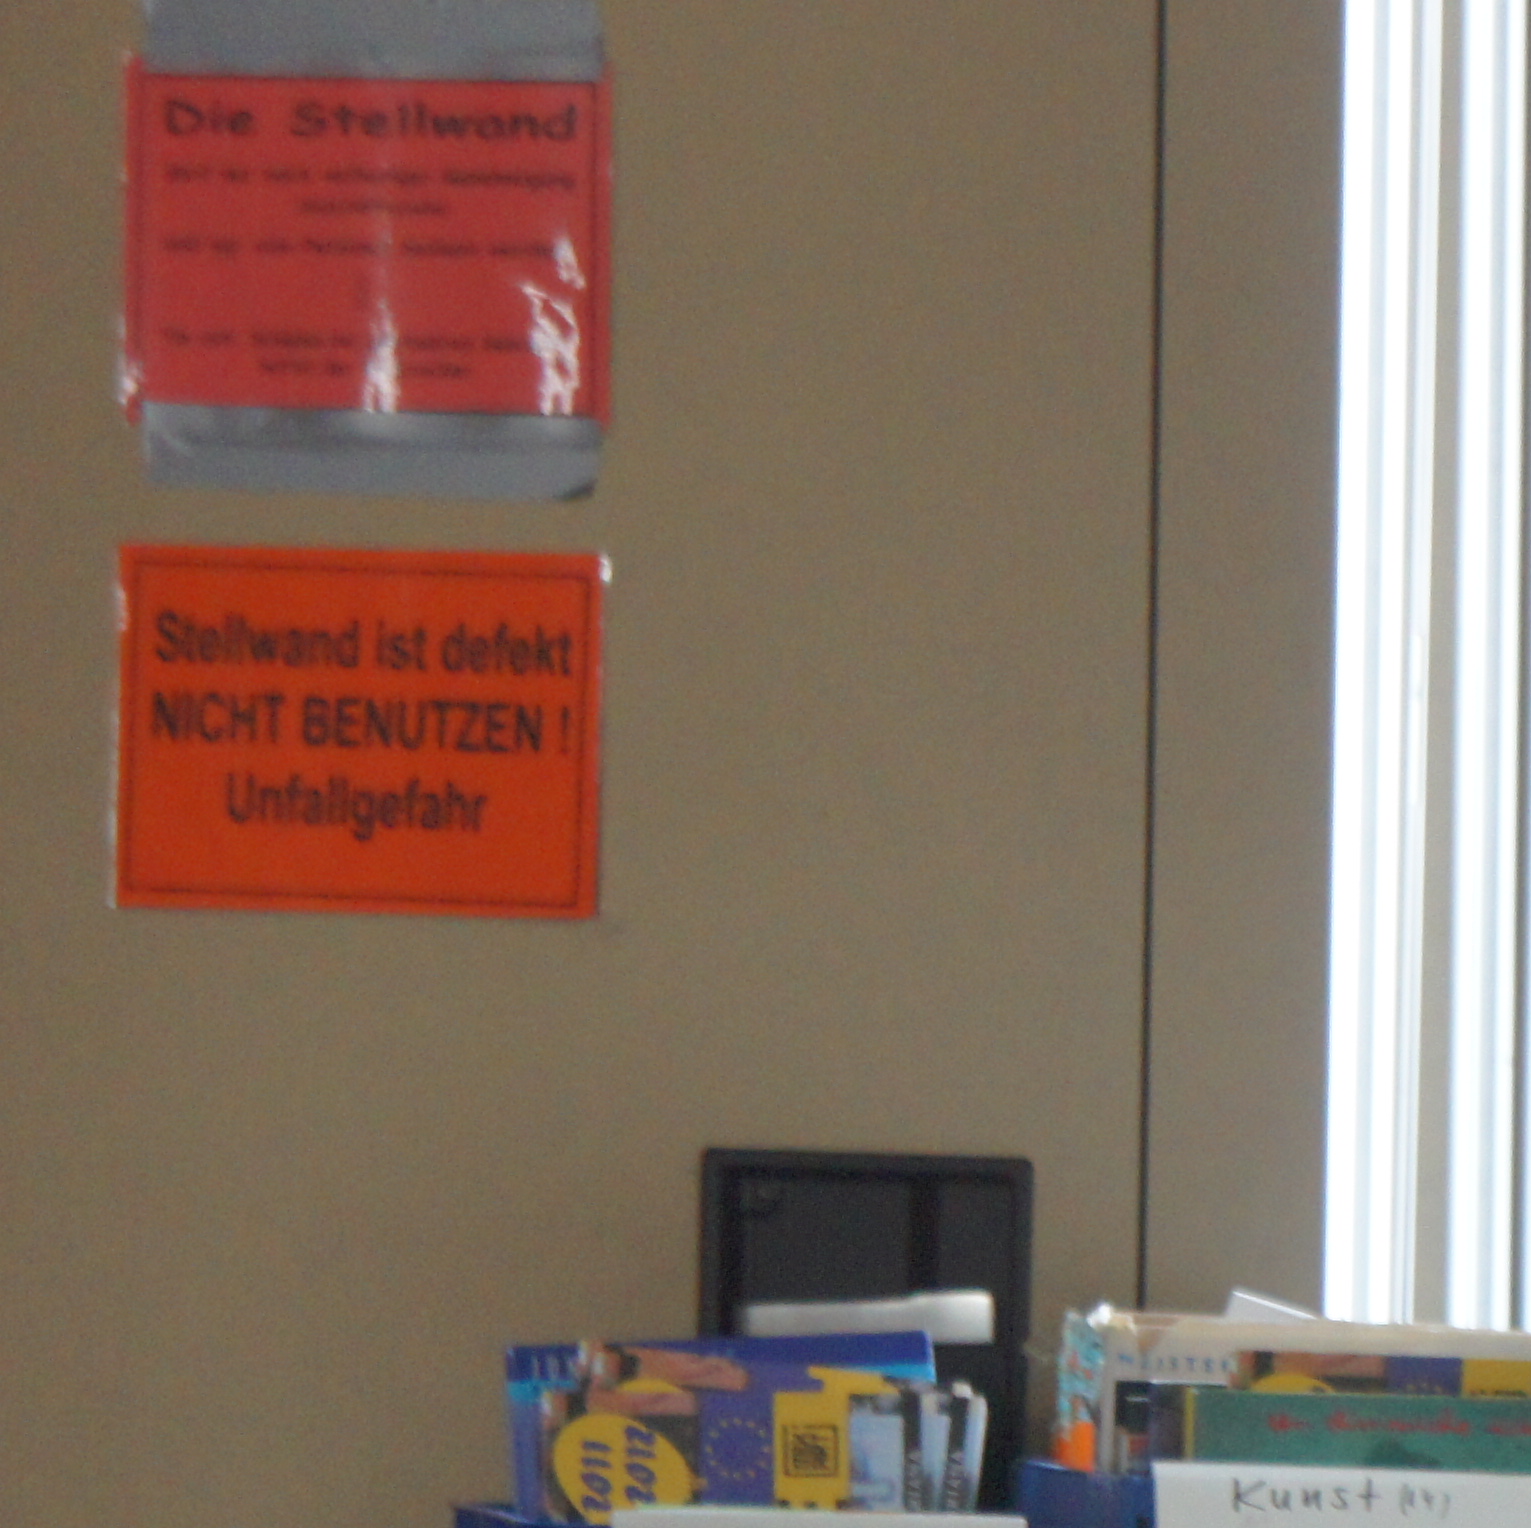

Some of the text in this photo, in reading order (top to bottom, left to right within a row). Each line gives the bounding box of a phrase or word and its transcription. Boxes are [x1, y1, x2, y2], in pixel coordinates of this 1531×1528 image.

[164, 98, 577, 142] Die Stellwand
[155, 609, 573, 676] Stellwand ist defekt
[151, 691, 285, 744] NICHT
[303, 696, 544, 754] BENUTZEN
[226, 772, 487, 841] Unfallgefahr
[580, 1440, 613, 1513] 2011
[624, 1425, 657, 1504] 2012
[1231, 1478, 1380, 1512] Kunst
